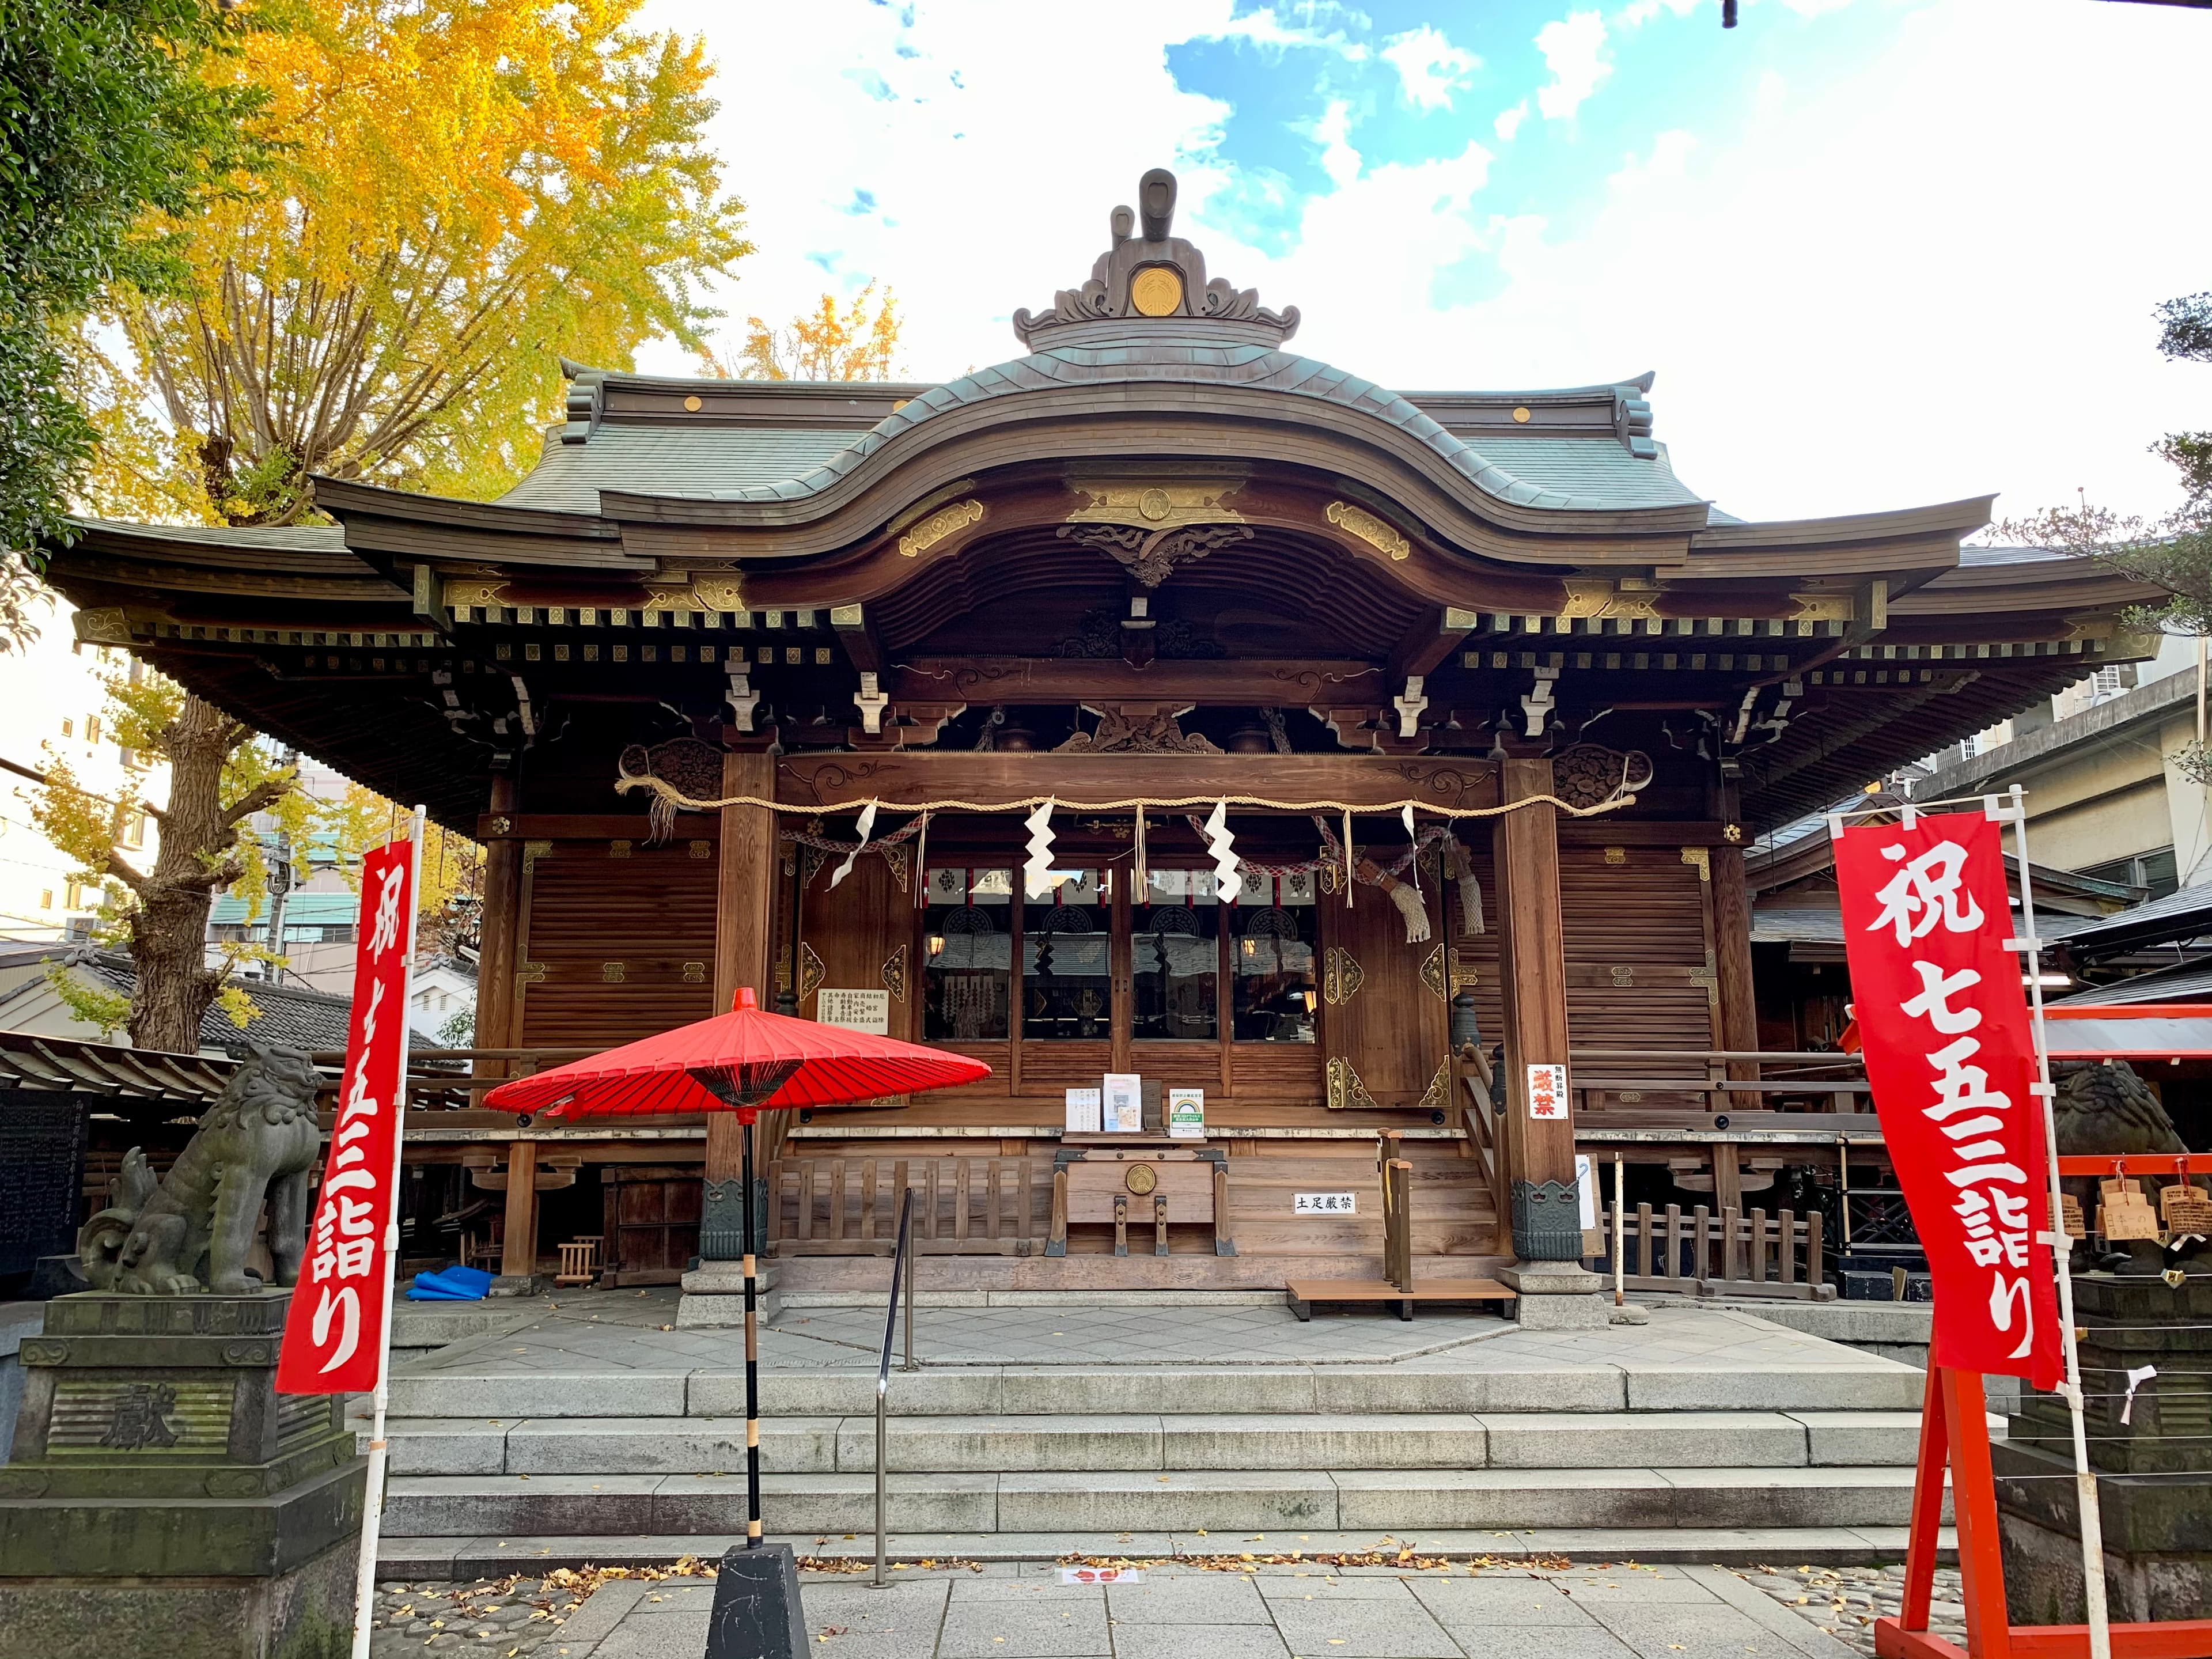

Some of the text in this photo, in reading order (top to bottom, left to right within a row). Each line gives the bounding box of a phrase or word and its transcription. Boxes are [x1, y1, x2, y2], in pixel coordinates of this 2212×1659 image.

[1532, 1070, 1555, 1116] 厳禁
[1555, 1066, 1564, 1098] 無断昇殿
[1297, 1196, 1352, 1209] 土足厳禁
[2106, 1213, 2146, 1226] 日本一の
